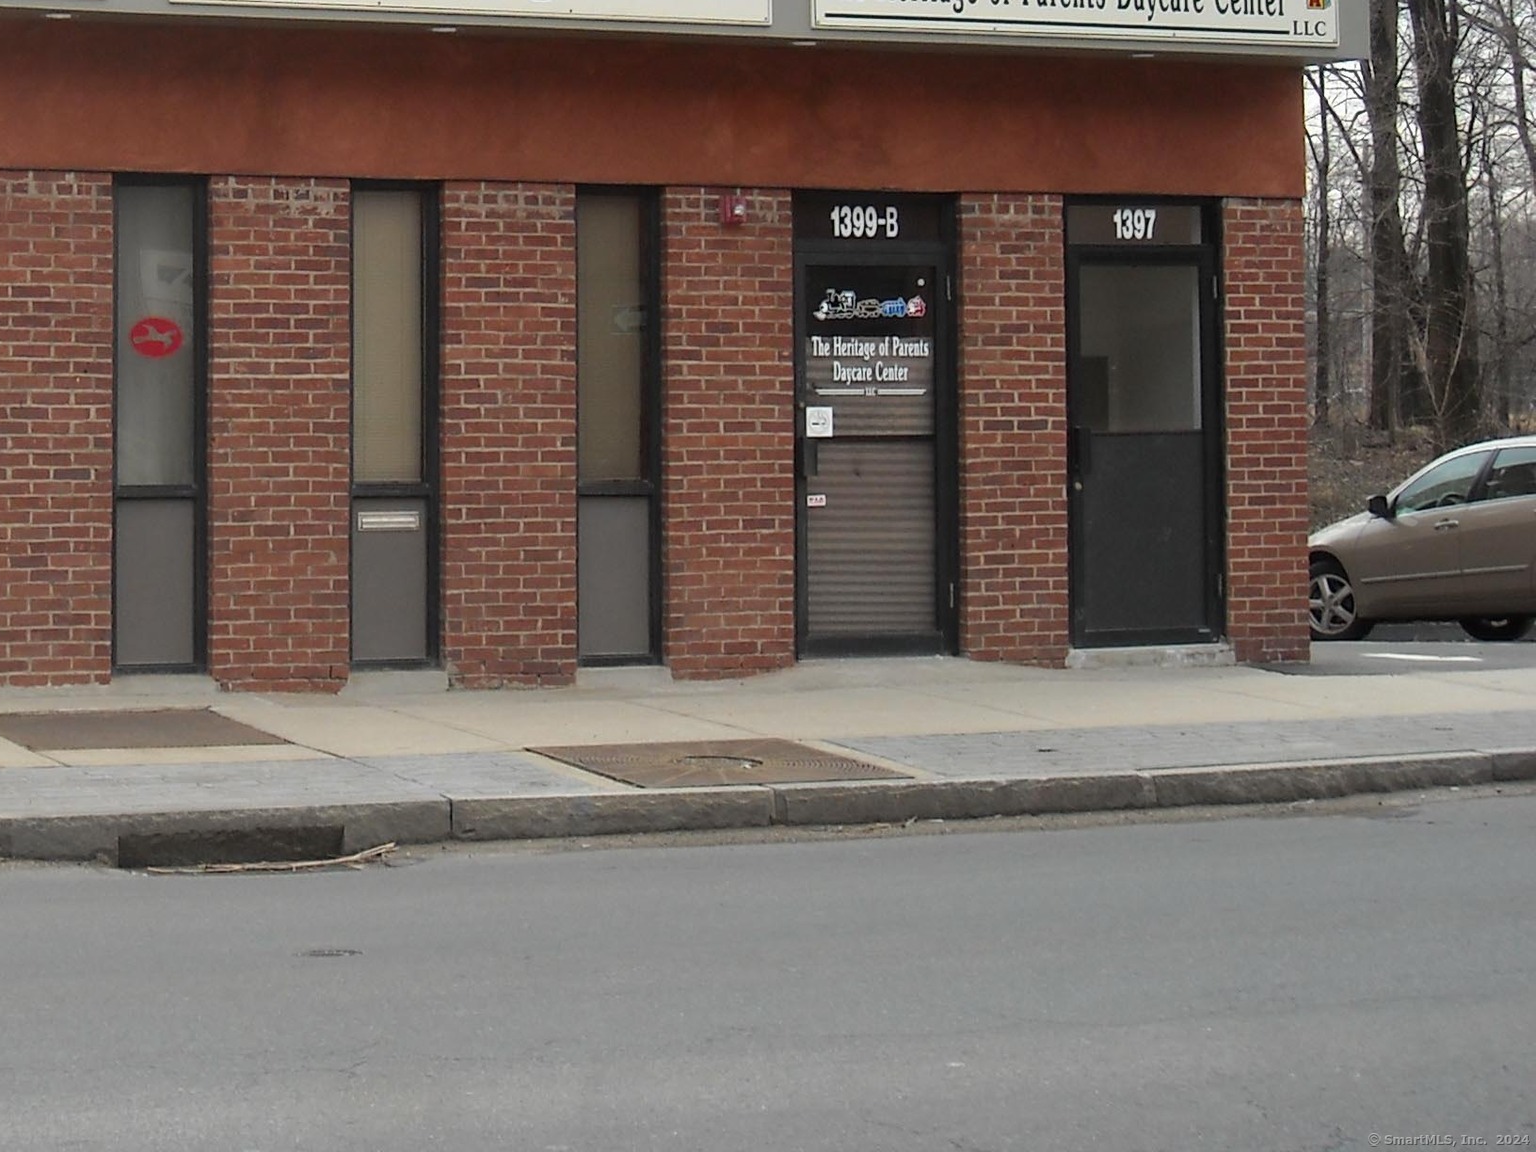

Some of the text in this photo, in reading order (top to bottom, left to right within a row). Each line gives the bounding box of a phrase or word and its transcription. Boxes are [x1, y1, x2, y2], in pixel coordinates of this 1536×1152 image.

[1293, 20, 1326, 36] LLC
[830, 205, 899, 238] 1399-B
[1114, 209, 1156, 239] 1397
[811, 336, 929, 361] The Heritage of Parents
[833, 360, 908, 385] Daycare Center
